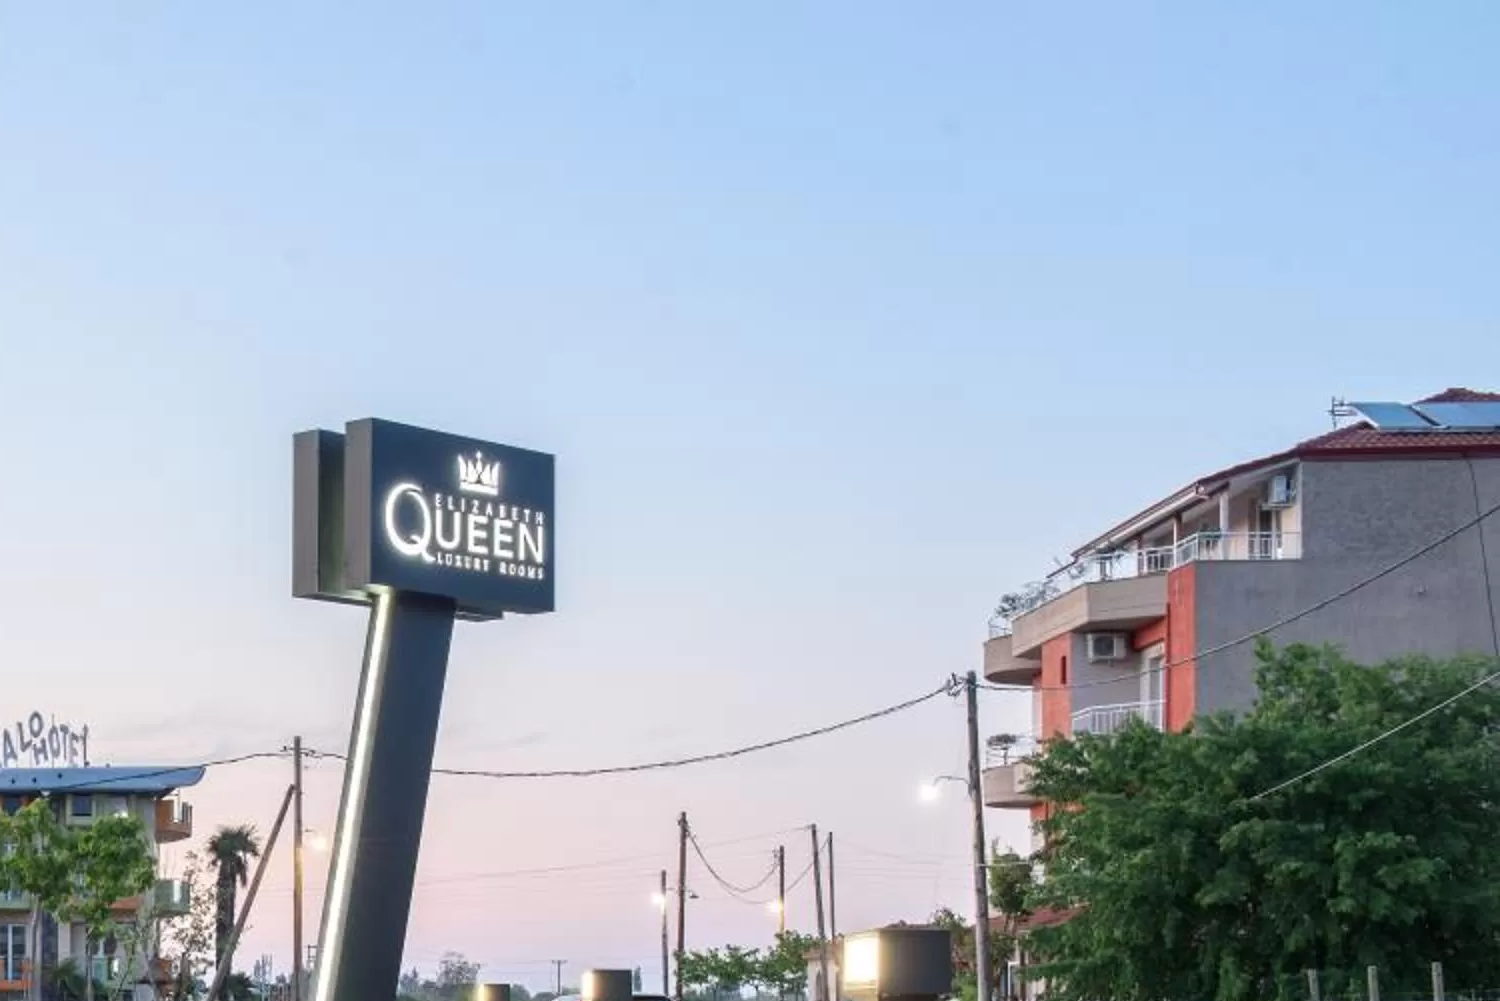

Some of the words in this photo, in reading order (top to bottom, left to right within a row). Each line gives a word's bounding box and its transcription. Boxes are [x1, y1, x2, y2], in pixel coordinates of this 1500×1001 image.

[384, 484, 544, 562] QUEEN
[435, 493, 545, 525] ELIZABETH
[436, 552, 490, 572] LUXURY
[499, 562, 544, 581] ROOMS
